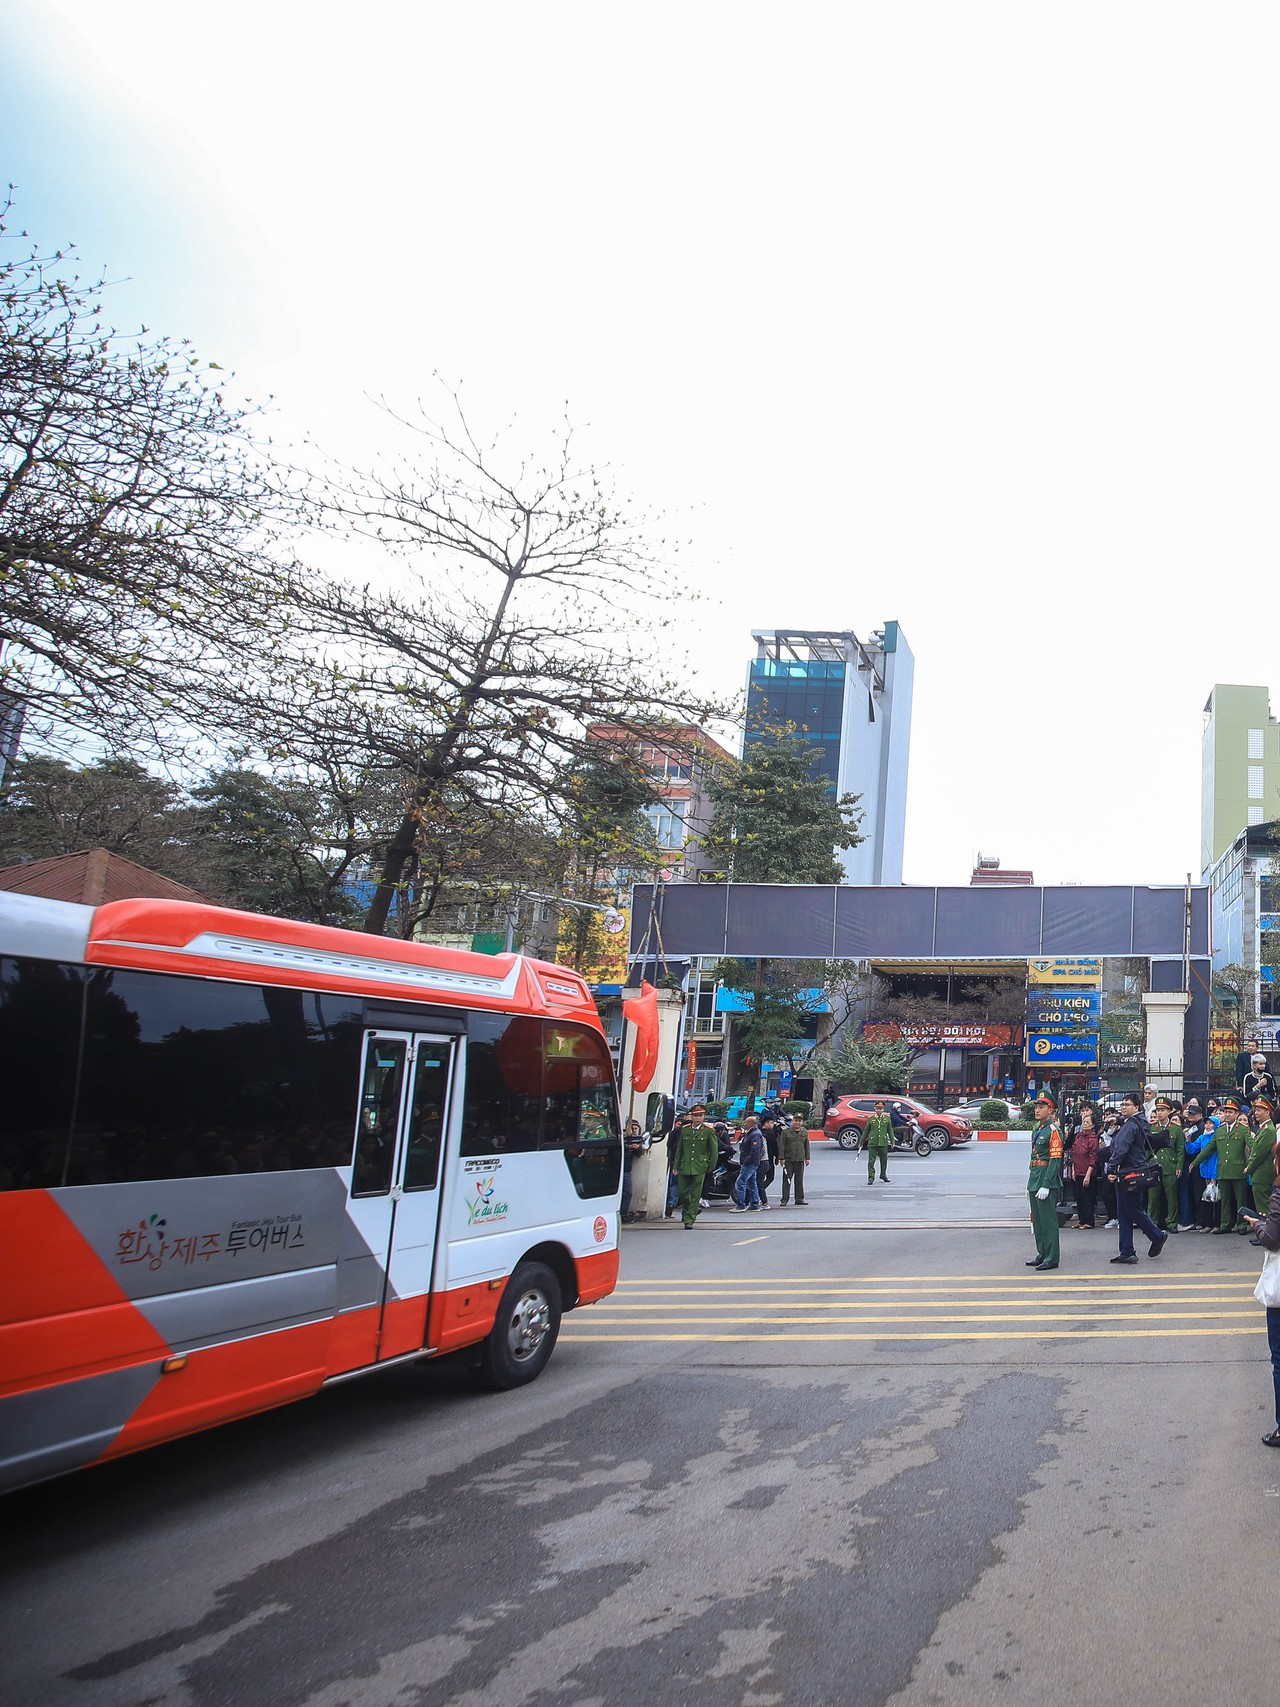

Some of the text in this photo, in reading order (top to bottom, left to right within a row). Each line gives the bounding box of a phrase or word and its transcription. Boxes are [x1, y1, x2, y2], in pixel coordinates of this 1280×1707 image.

[1039, 1011, 1062, 1023] CHÓ
[783, 1071, 790, 1079] P
[481, 1204, 492, 1216] du
[115, 1224, 305, 1271] 환상 제주 투어버스
